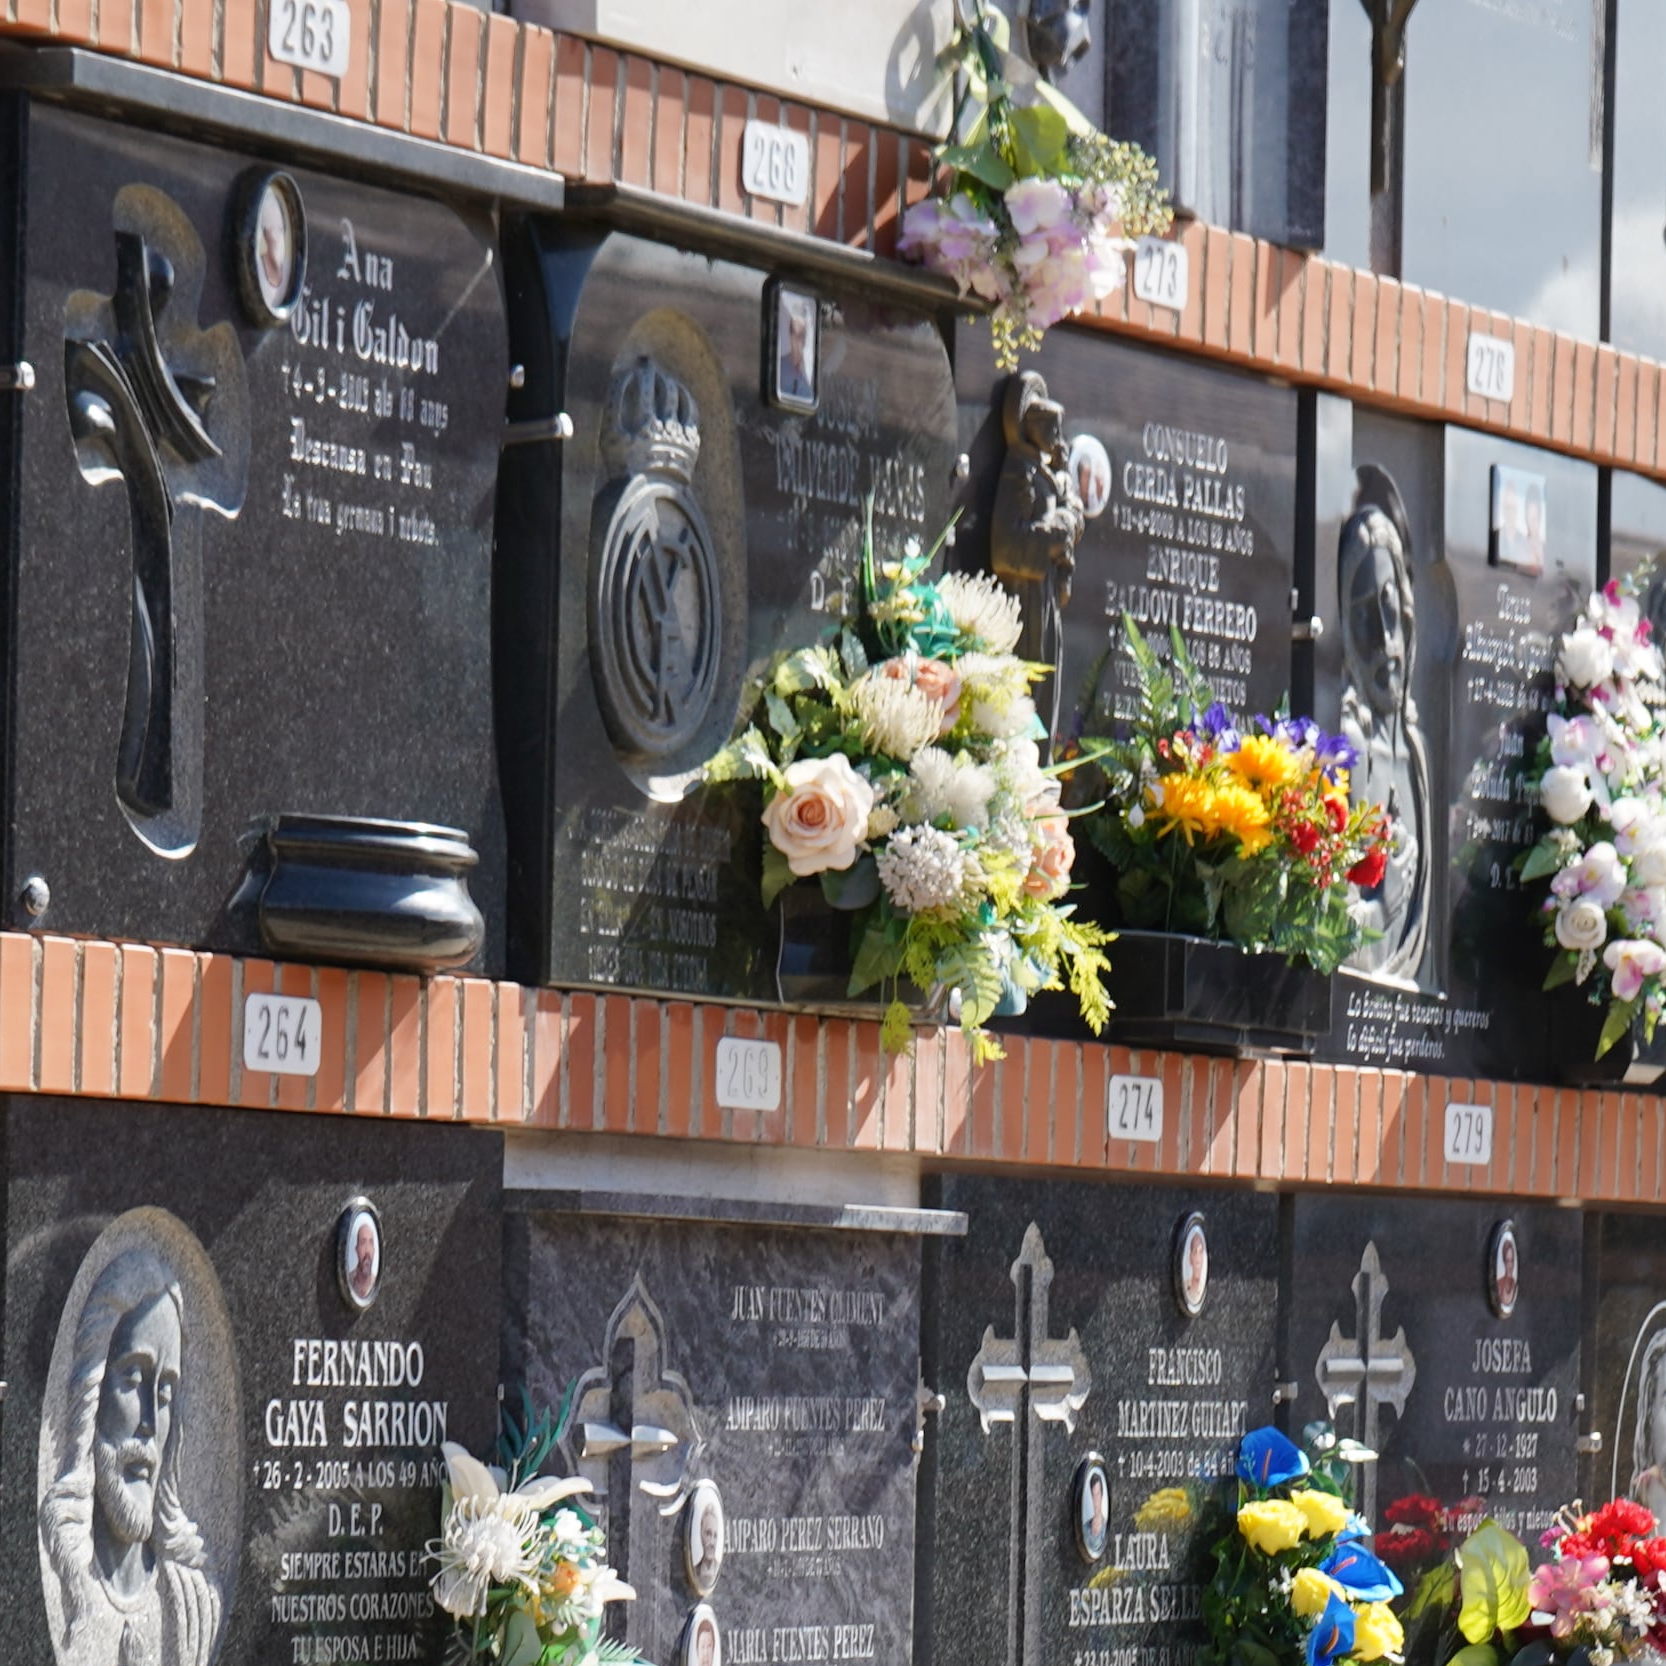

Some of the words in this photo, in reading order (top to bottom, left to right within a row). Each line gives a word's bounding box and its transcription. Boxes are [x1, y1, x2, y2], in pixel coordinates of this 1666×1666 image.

[283, 0, 332, 61] 263
[753, 136, 796, 191] 268
[337, 217, 393, 291] Ana
[1144, 245, 1177, 299] 273
[353, 298, 438, 375] Galdon
[291, 416, 366, 475] Descansa
[1143, 422, 1228, 475] CONSUELO
[1123, 461, 1178, 507] CERDA
[1183, 476, 1245, 522] PALLAS
[1147, 544, 1220, 595] ENRIQUE
[1183, 592, 1257, 642] FERRERO
[258, 1004, 307, 1062] 264
[727, 1047, 769, 1098] 269
[1119, 1083, 1153, 1130] 274
[1453, 1112, 1484, 1154] 279
[732, 1285, 765, 1320] JUAN
[770, 1288, 826, 1322] FUENTES
[293, 1339, 424, 1387] FERNANDO
[1148, 1348, 1222, 1385] FRANCISCO
[1472, 1339, 1531, 1373] JOSEFA
[265, 1399, 328, 1447] GAYA
[343, 1400, 448, 1447] SARRION
[726, 1397, 780, 1431] AMPARO
[784, 1397, 841, 1431] FUENTES
[845, 1398, 885, 1432] PEREZ
[1117, 1400, 1188, 1438] MARTINEZ
[1192, 1402, 1248, 1438] GUITART
[1445, 1387, 1486, 1422] CANO
[1493, 1388, 1557, 1422] ANGULO
[368, 1461, 395, 1488] LOS
[399, 1461, 416, 1488] 49
[724, 1517, 777, 1553] AMPARO
[781, 1517, 822, 1552] PEREZ
[827, 1515, 883, 1549] SERRANO
[1115, 1533, 1170, 1570] LAURA
[281, 1552, 341, 1581] SIEMPRE
[345, 1551, 405, 1578] ESTARAS
[271, 1593, 346, 1623] NUESTROS
[350, 1592, 434, 1620] CORAZONES
[1069, 1586, 1145, 1627] ESPARZA
[316, 1635, 369, 1663] ESPOSA
[726, 1627, 767, 1665] MARIA
[772, 1626, 830, 1662] FUENTES
[834, 1624, 874, 1659] PEREZ
